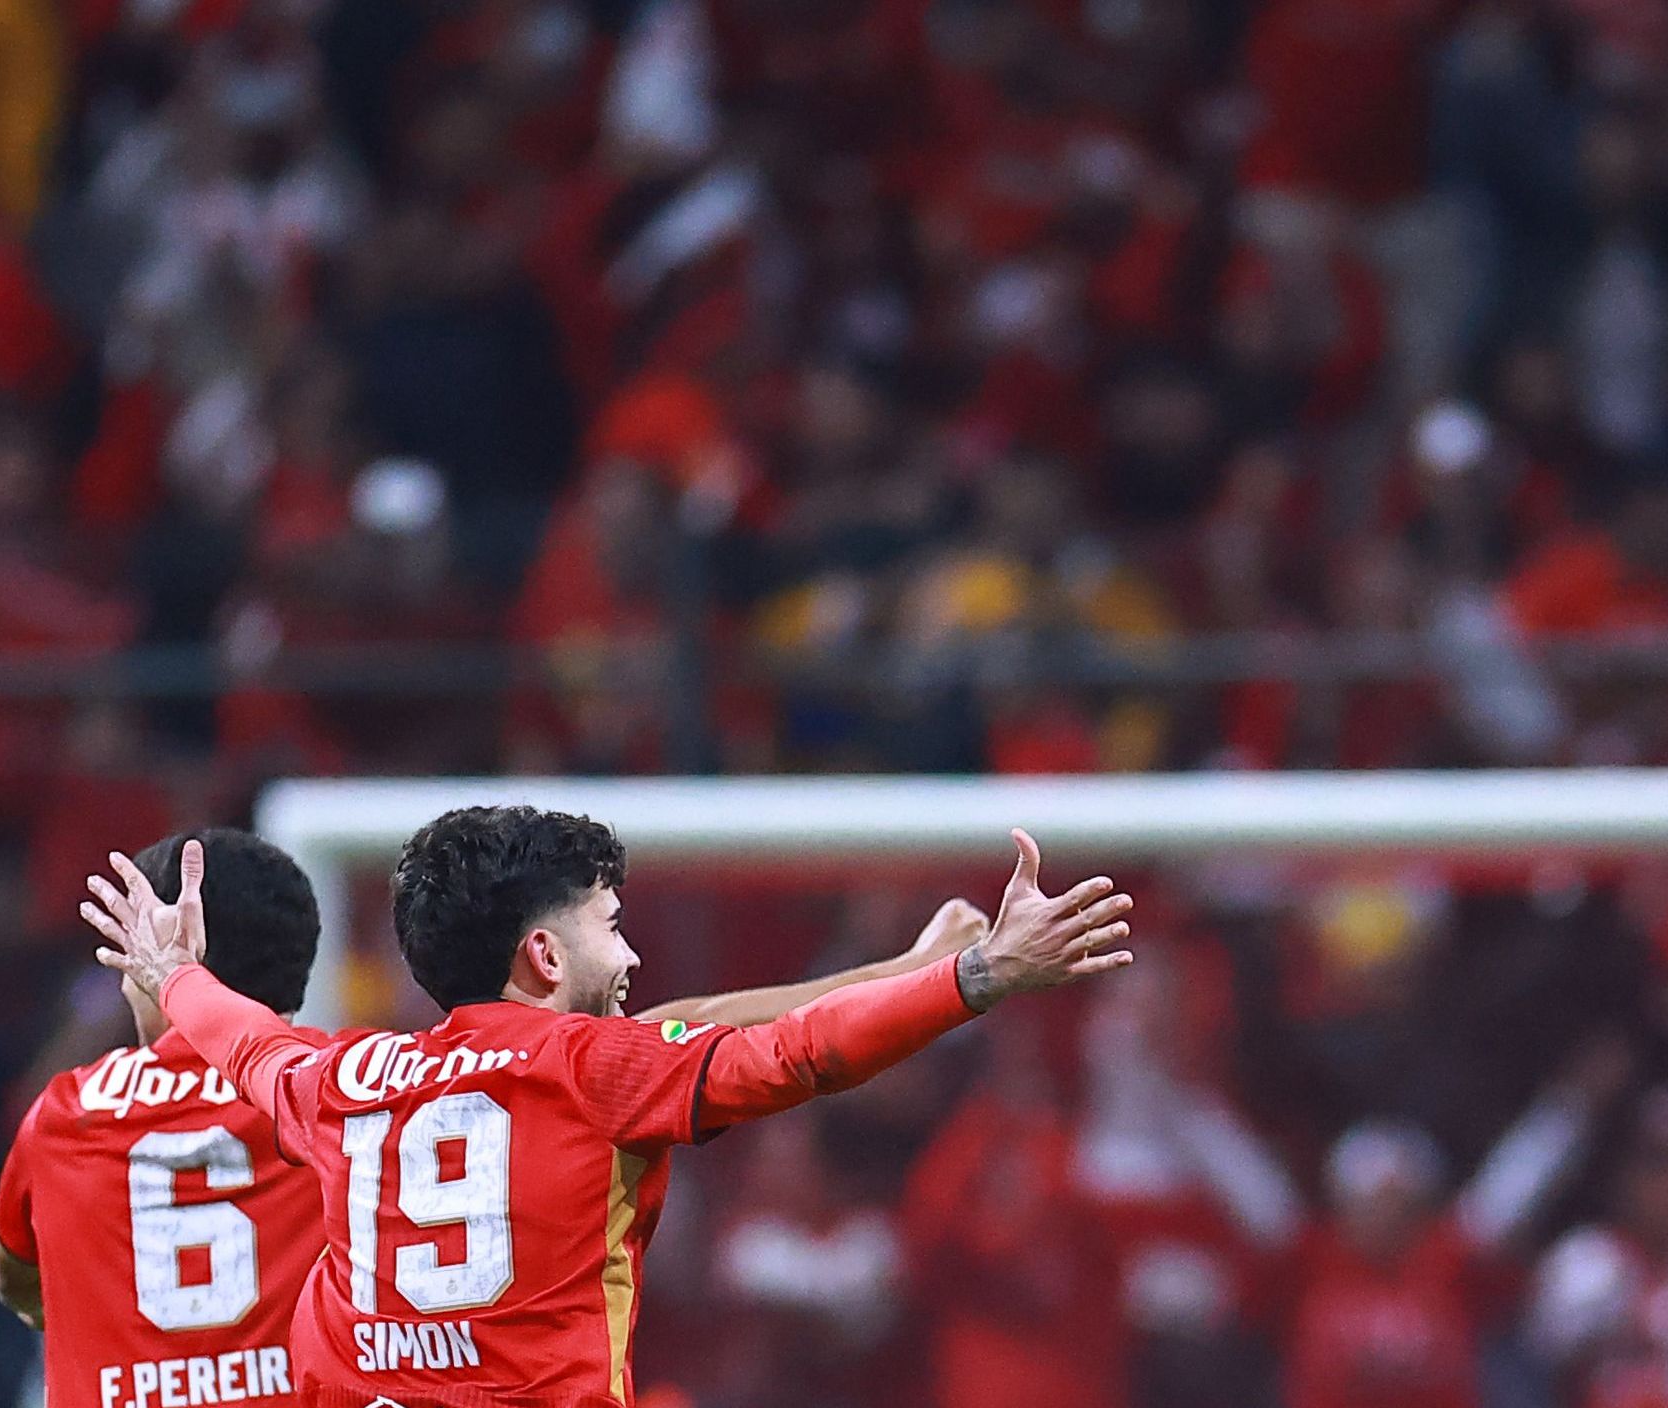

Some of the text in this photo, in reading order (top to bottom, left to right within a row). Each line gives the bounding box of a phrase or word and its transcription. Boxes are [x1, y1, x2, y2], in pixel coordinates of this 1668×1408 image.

[337, 1031, 529, 1103] Coron
[128, 1125, 259, 1332] 6
[342, 1091, 514, 1314] 19
[353, 1320, 480, 1372] SIMON
